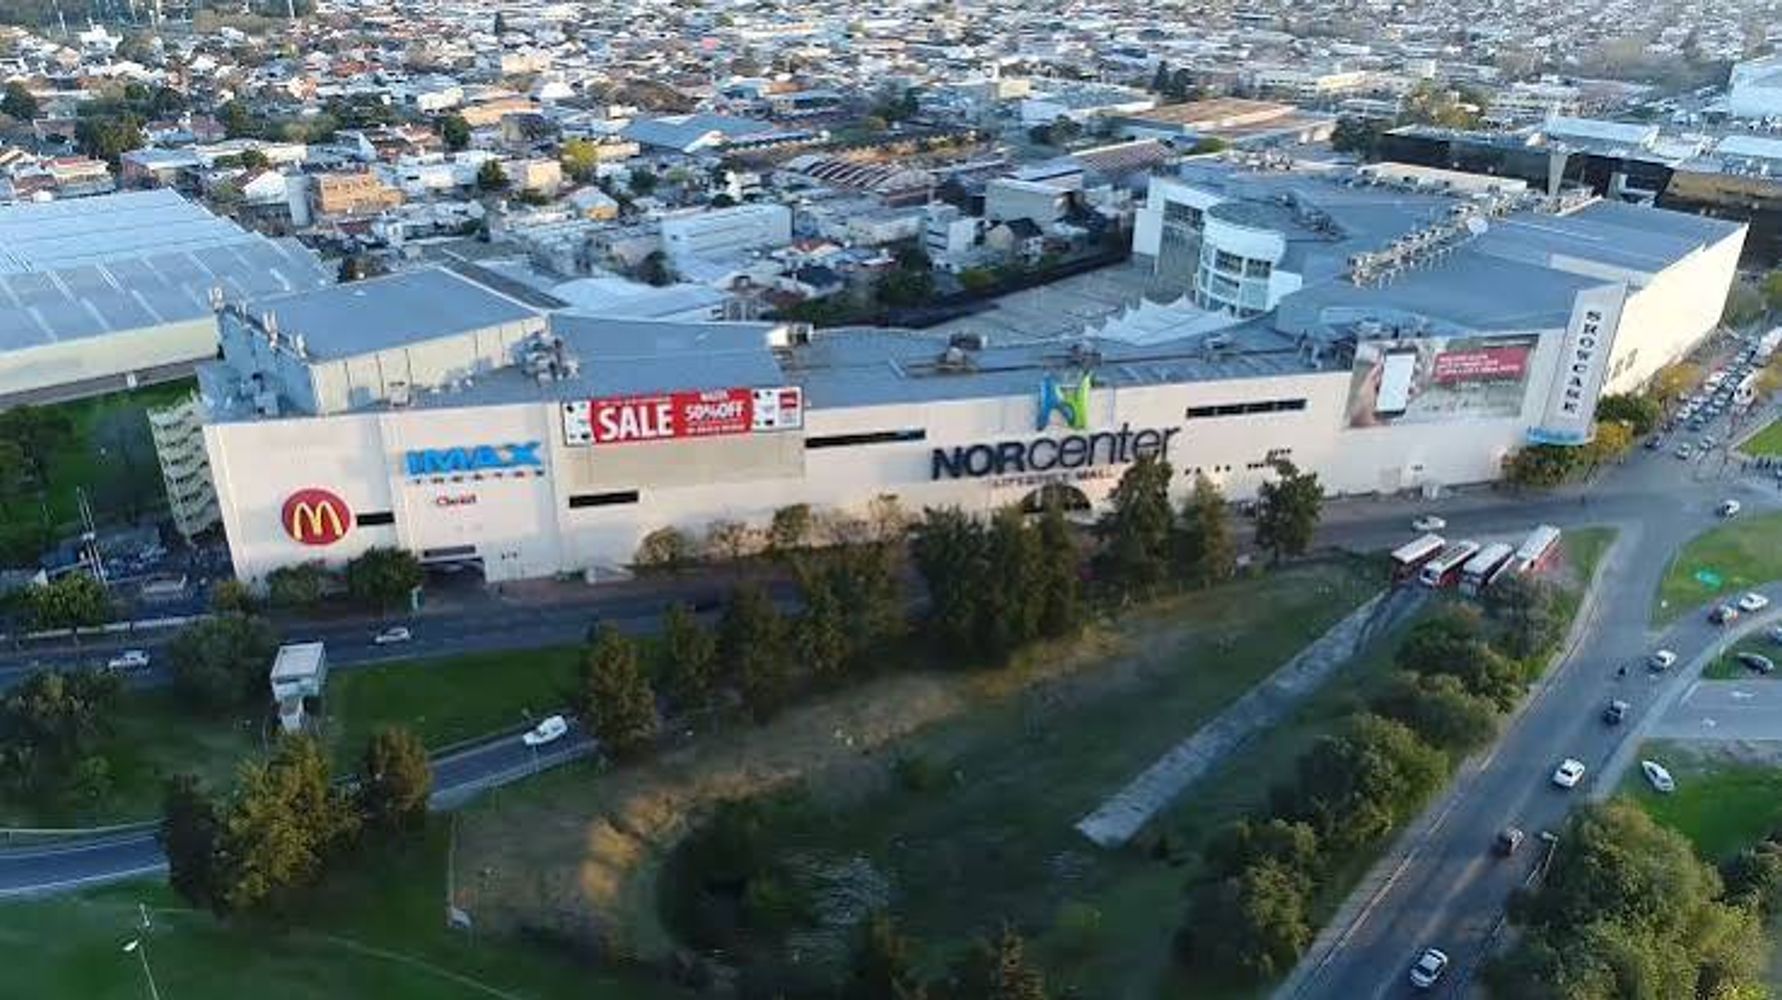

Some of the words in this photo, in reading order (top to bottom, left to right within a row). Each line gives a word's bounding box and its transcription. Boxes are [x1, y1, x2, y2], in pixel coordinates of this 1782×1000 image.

[599, 402, 674, 441] SALE
[405, 442, 542, 476] IMAX
[930, 421, 1182, 480] NORcenter
